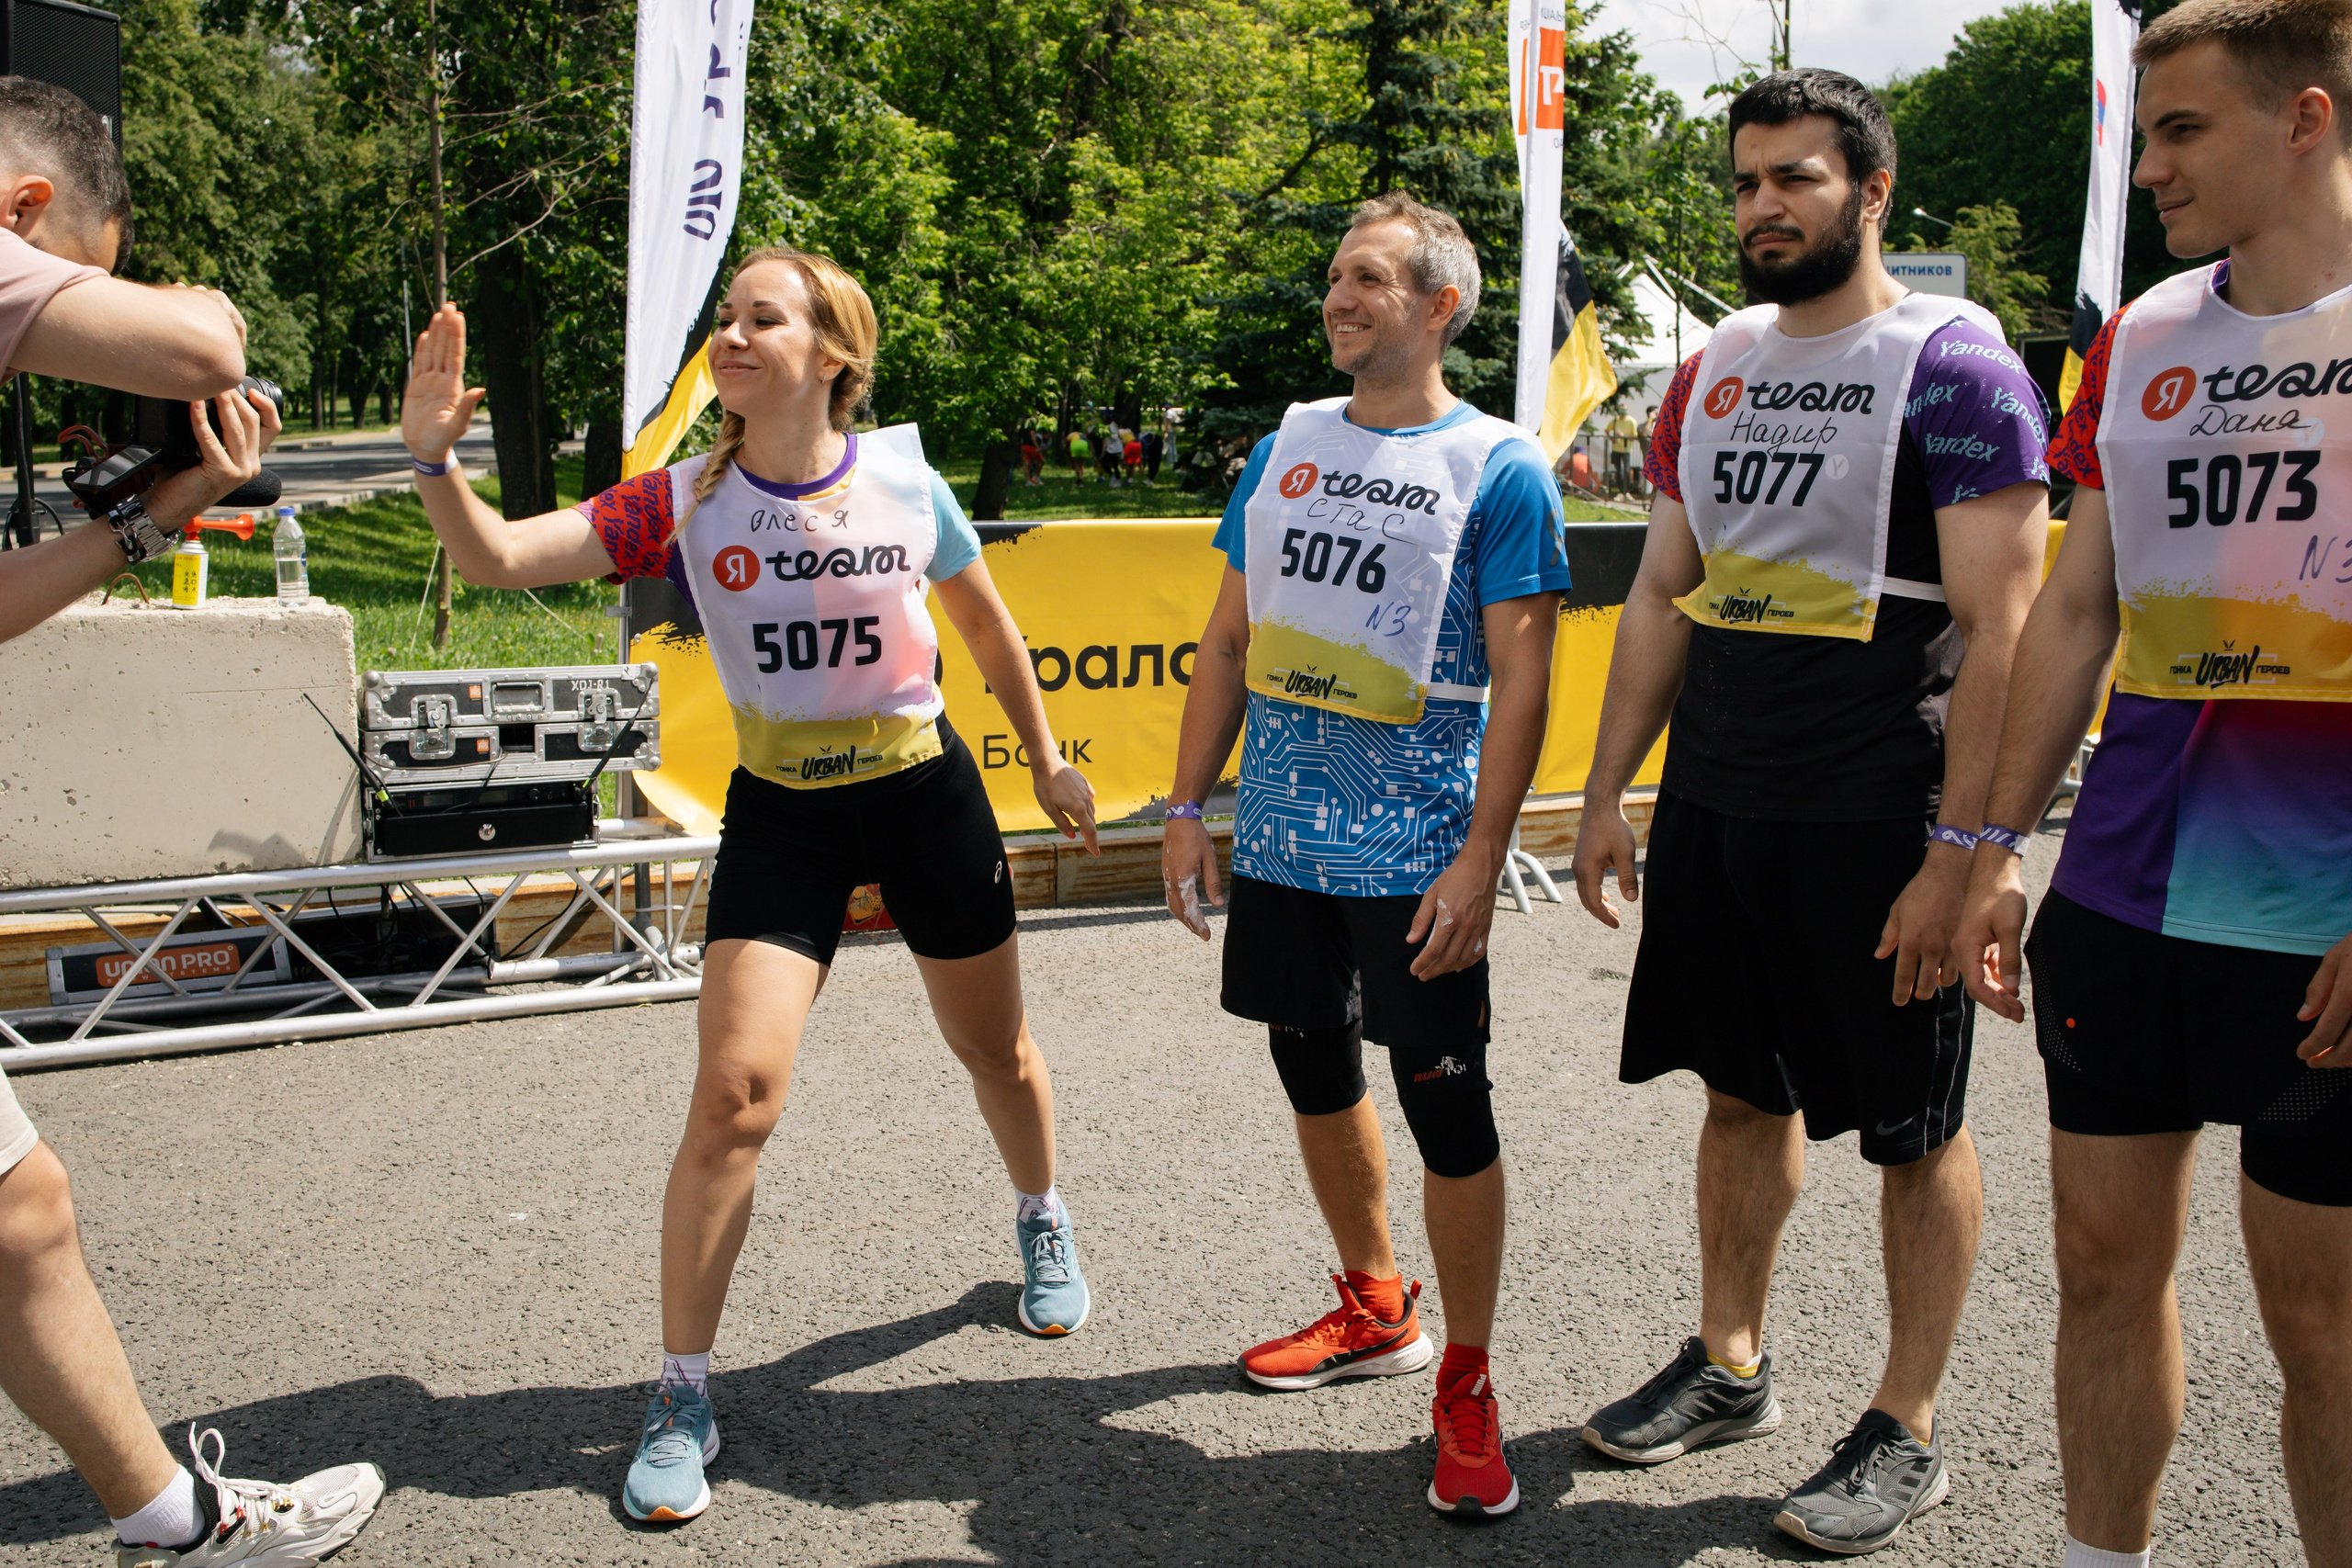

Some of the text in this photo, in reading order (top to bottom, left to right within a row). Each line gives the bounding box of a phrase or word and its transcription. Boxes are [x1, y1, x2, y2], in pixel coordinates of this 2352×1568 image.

[1940, 341, 2022, 375] Yandex
[1747, 381, 1875, 415] team
[1731, 410, 1837, 458] Надир
[2189, 404, 2312, 436] Даня
[1321, 470, 1440, 515] team
[1713, 451, 1825, 507] 5077
[2167, 450, 2321, 529] 5073
[765, 544, 911, 581] team
[1281, 527, 1386, 594] 5076
[1720, 593, 1772, 625] URBAN
[1767, 609, 1794, 618] ГЕРОЕВ
[752, 615, 882, 674] 5075
[985, 636, 1200, 694] ралс
[2169, 644, 2290, 689] ГОНКА URBAN ГЕРОЕВ
[571, 680, 610, 692] XDJ-R1
[1284, 670, 1337, 700] URBAN
[1333, 688, 1358, 700] ГЕРОЕВ
[801, 745, 856, 781] URBAN
[856, 754, 884, 765] ГЕРОЕВ
[181, 949, 231, 968] PRO
